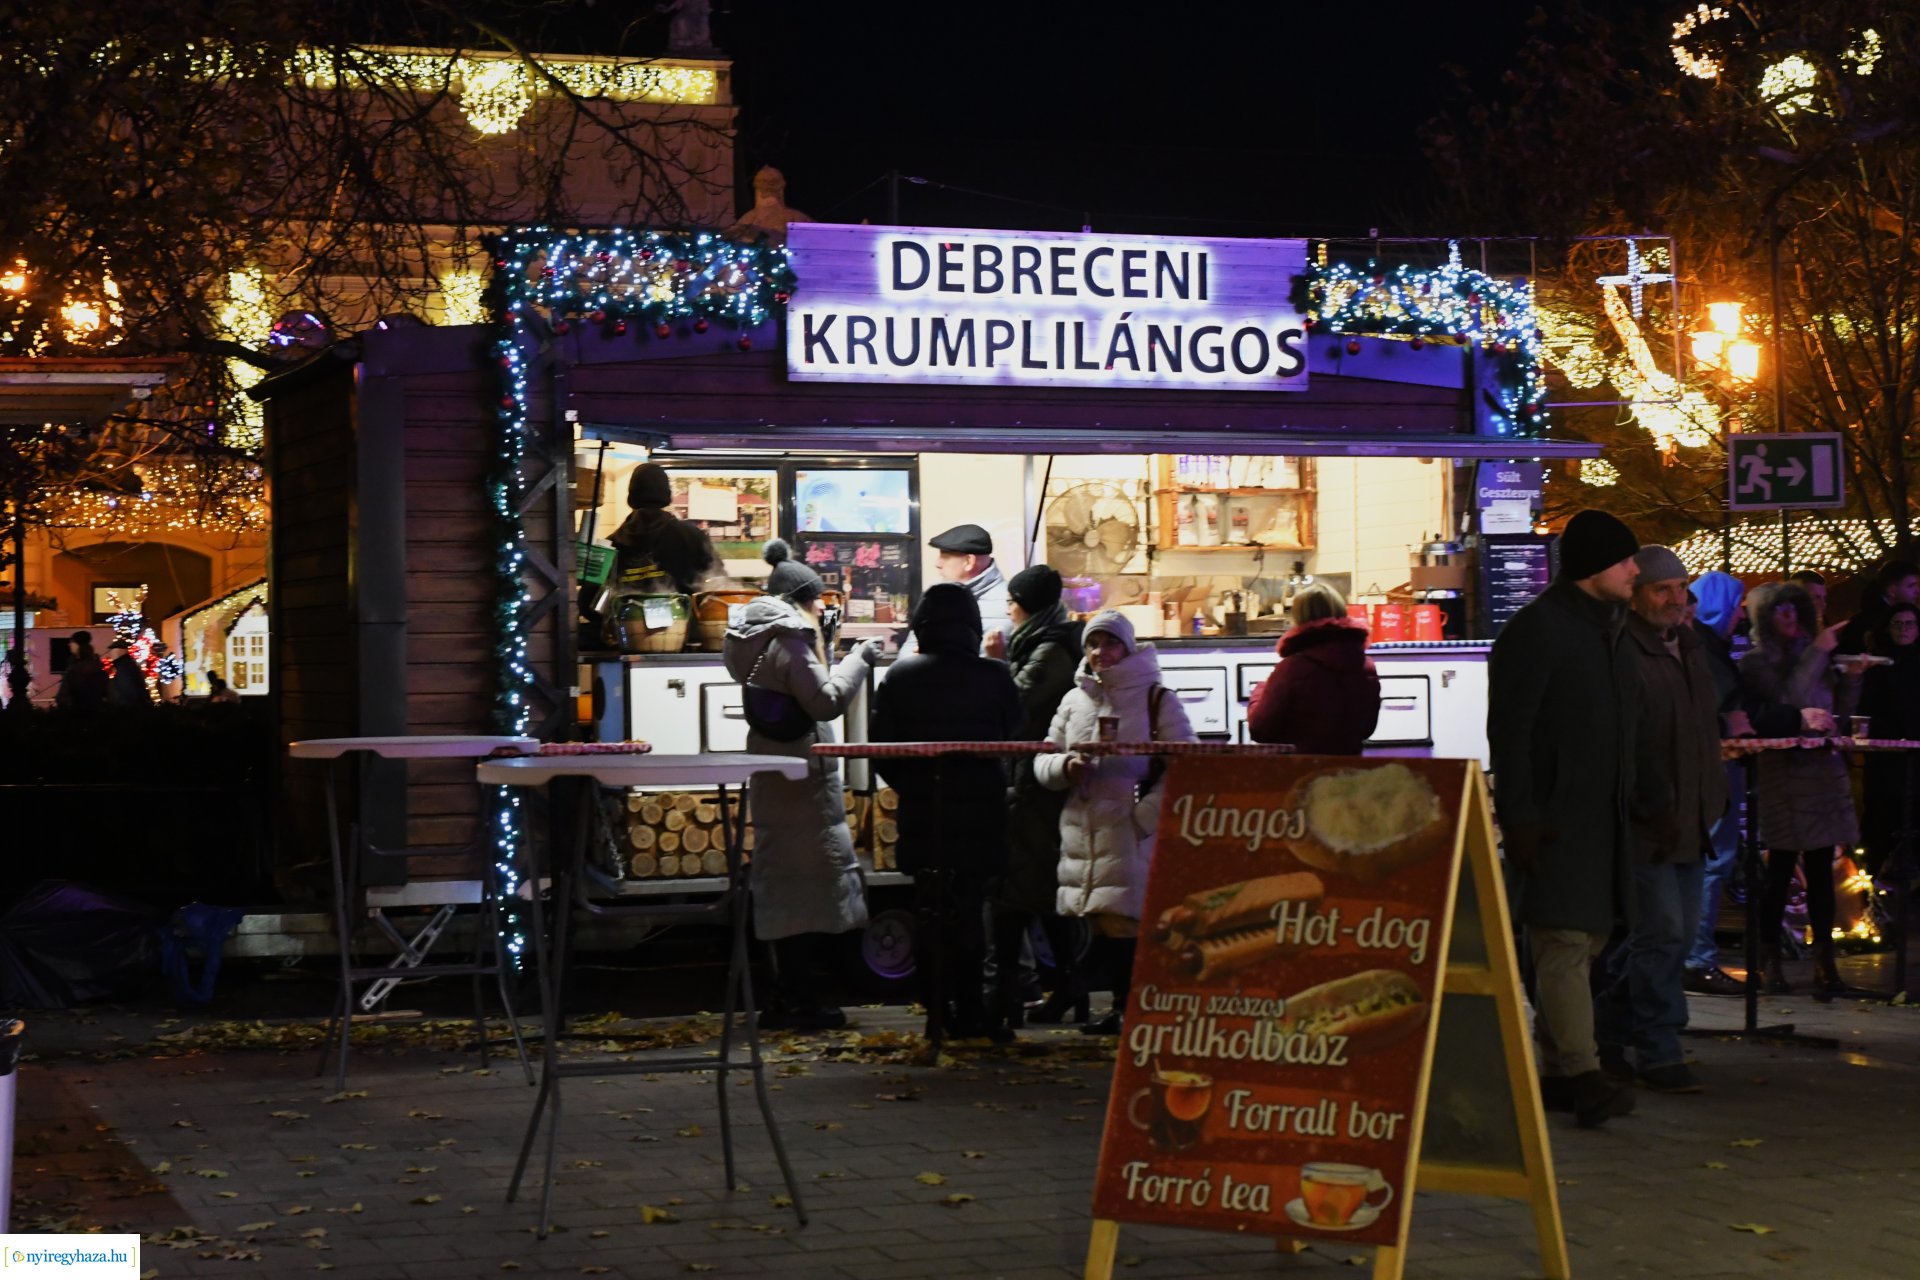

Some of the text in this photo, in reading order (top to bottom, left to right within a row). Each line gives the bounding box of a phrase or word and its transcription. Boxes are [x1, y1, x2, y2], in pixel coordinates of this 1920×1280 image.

[892, 240, 1208, 301] DEBRECENI
[802, 311, 1305, 377] KRUMPLILÁNGOS
[1173, 795, 1305, 851] Lángos
[1270, 900, 1430, 965] Hot-dog
[1140, 985, 1285, 1017] Curry szószos
[1129, 1013, 1349, 1067] grillkolbász
[1223, 1089, 1404, 1141] Forralt bor
[1122, 1161, 1270, 1213] Forró tea
